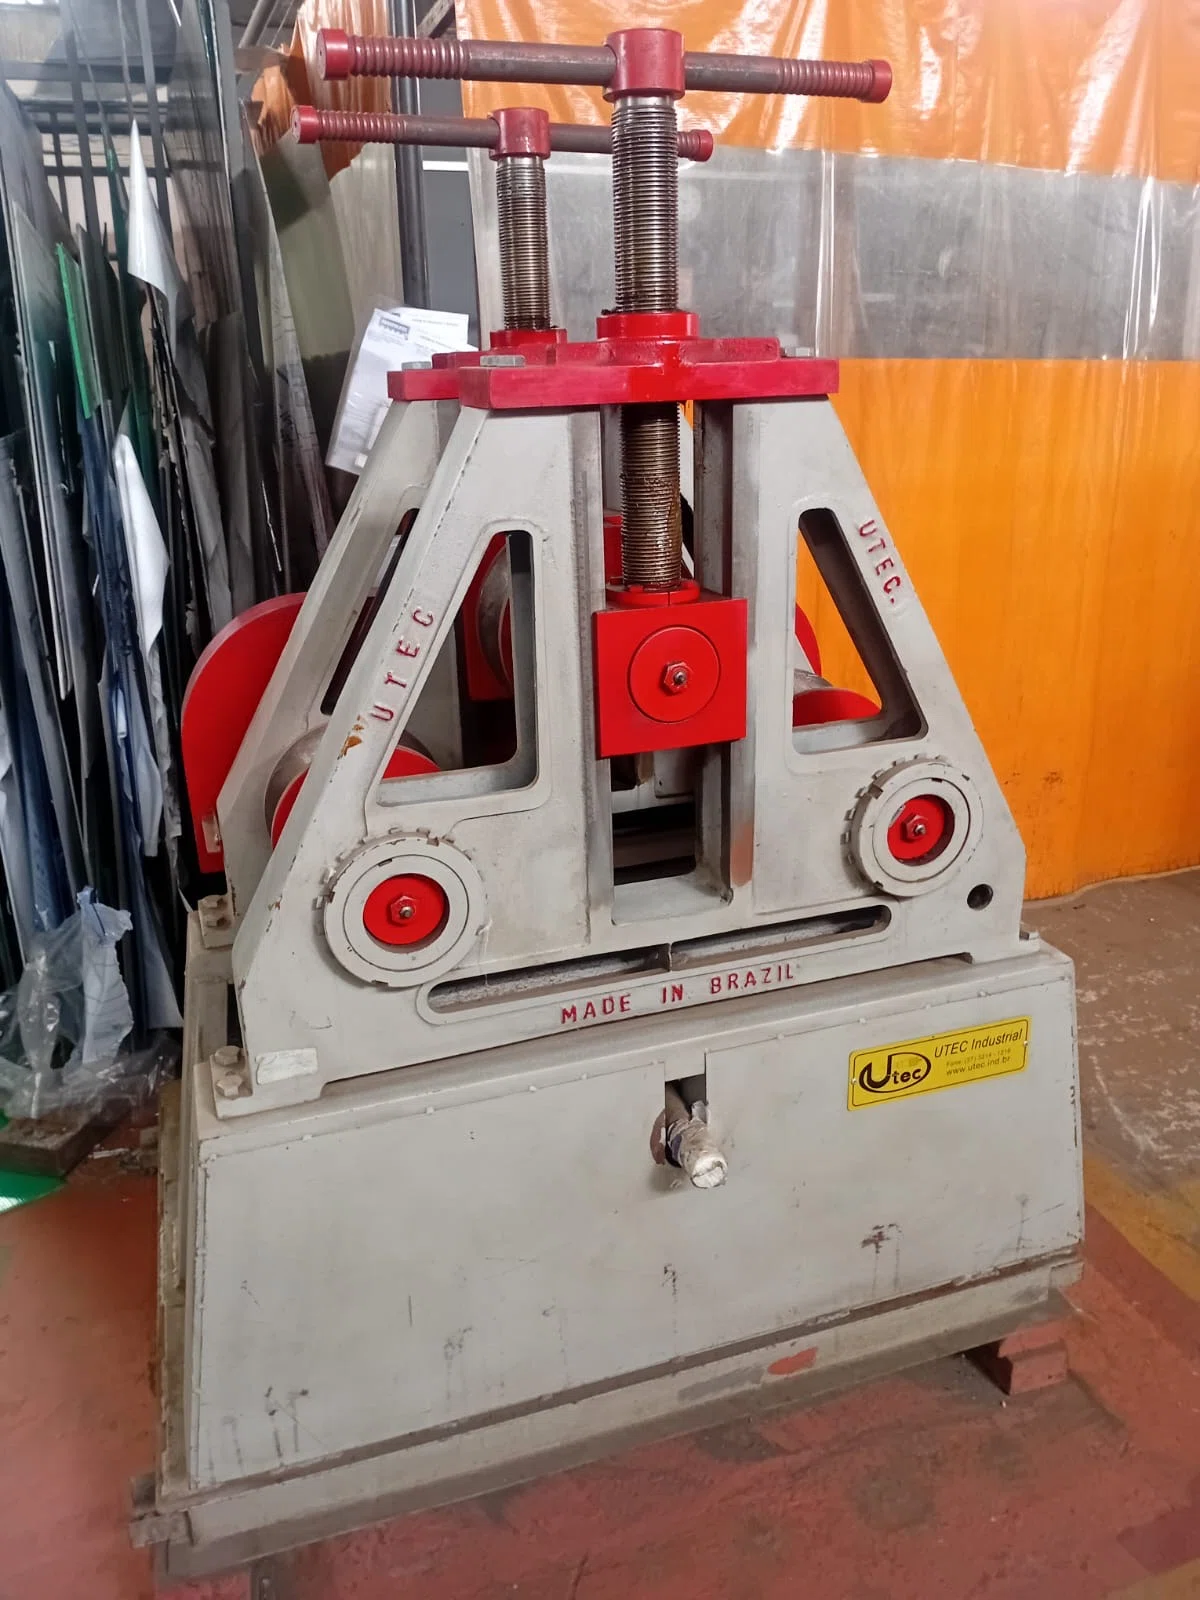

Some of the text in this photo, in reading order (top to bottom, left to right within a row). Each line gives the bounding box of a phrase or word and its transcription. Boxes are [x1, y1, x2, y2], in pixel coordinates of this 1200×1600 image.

[370, 608, 434, 722] UTEC
[560, 963, 794, 1025] MADE IN BRAZIL
[934, 1029, 1023, 1058] UTEC Industrial
[859, 1053, 922, 1089] Utec
